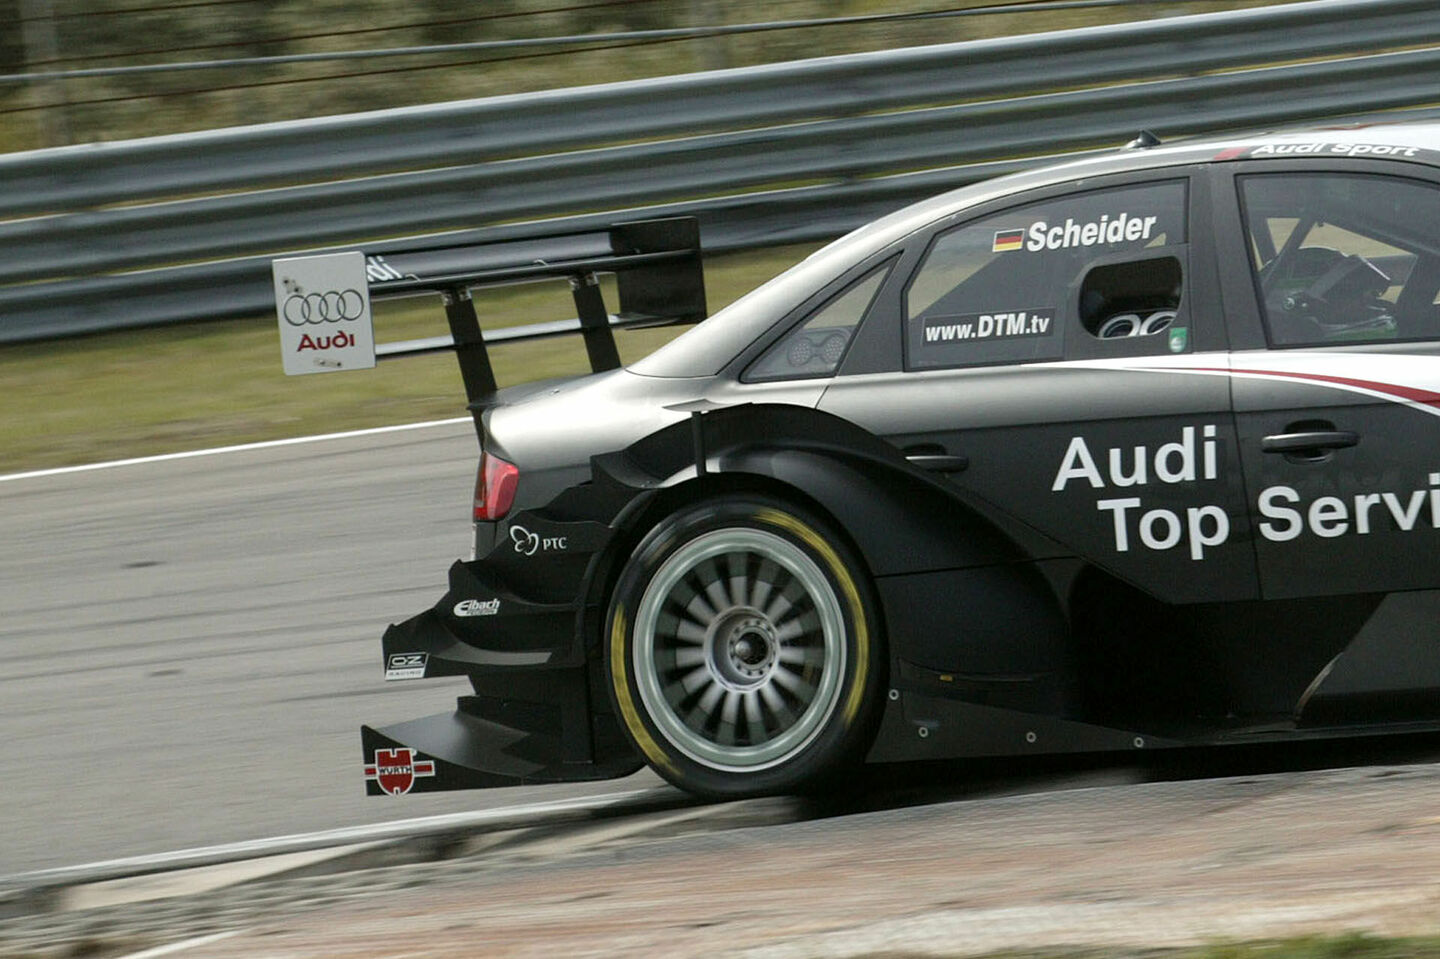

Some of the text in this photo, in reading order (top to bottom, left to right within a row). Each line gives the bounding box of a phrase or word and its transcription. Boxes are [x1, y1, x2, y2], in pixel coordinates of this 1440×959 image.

[1251, 143, 1421, 157] Audi Sport
[1027, 213, 1157, 252] Scheider
[367, 256, 402, 282] di
[925, 313, 1050, 342] www.DTM.tv
[296, 331, 355, 352] Audi
[1051, 425, 1217, 492] Audi
[1097, 496, 1231, 561] Top
[543, 537, 568, 550] PTC
